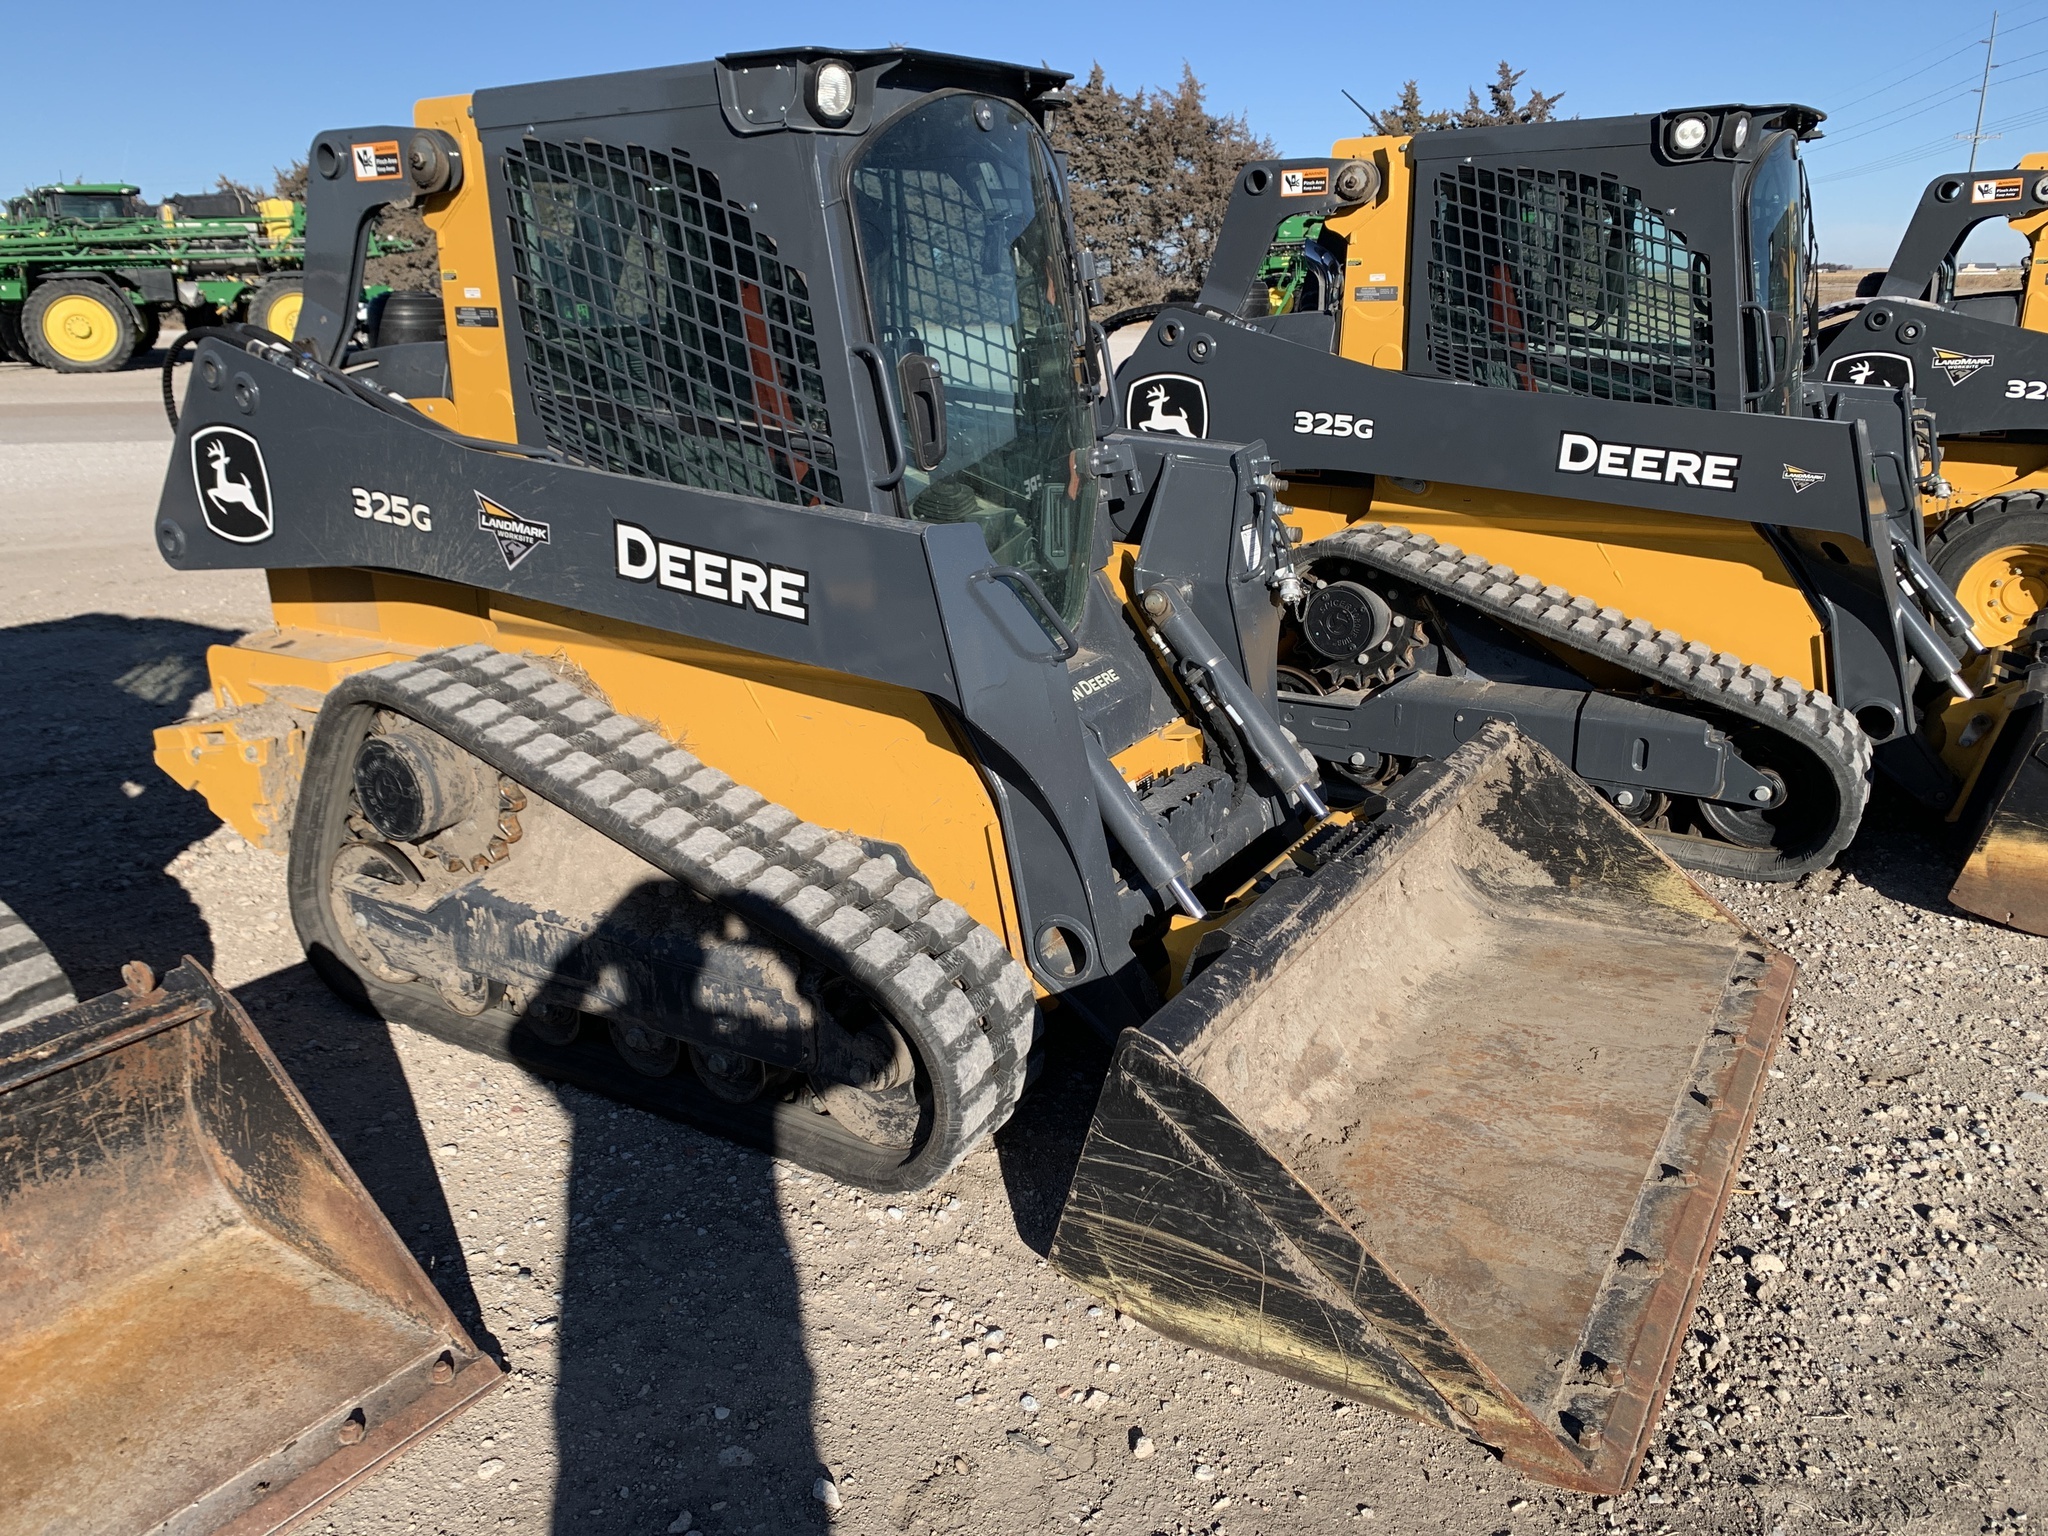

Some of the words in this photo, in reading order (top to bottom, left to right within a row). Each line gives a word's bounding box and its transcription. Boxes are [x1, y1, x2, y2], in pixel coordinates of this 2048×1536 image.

[1935, 357, 1991, 366] LANDMARK
[2004, 379, 2048, 400] 32
[1293, 410, 1375, 440] 325G
[1557, 432, 1739, 490] DEERE
[351, 487, 433, 532] 325G
[481, 514, 547, 540] LANDMARK
[496, 529, 534, 545] WORKSITE
[615, 522, 807, 621] DEERE
[1078, 668, 1121, 695] DEERE
